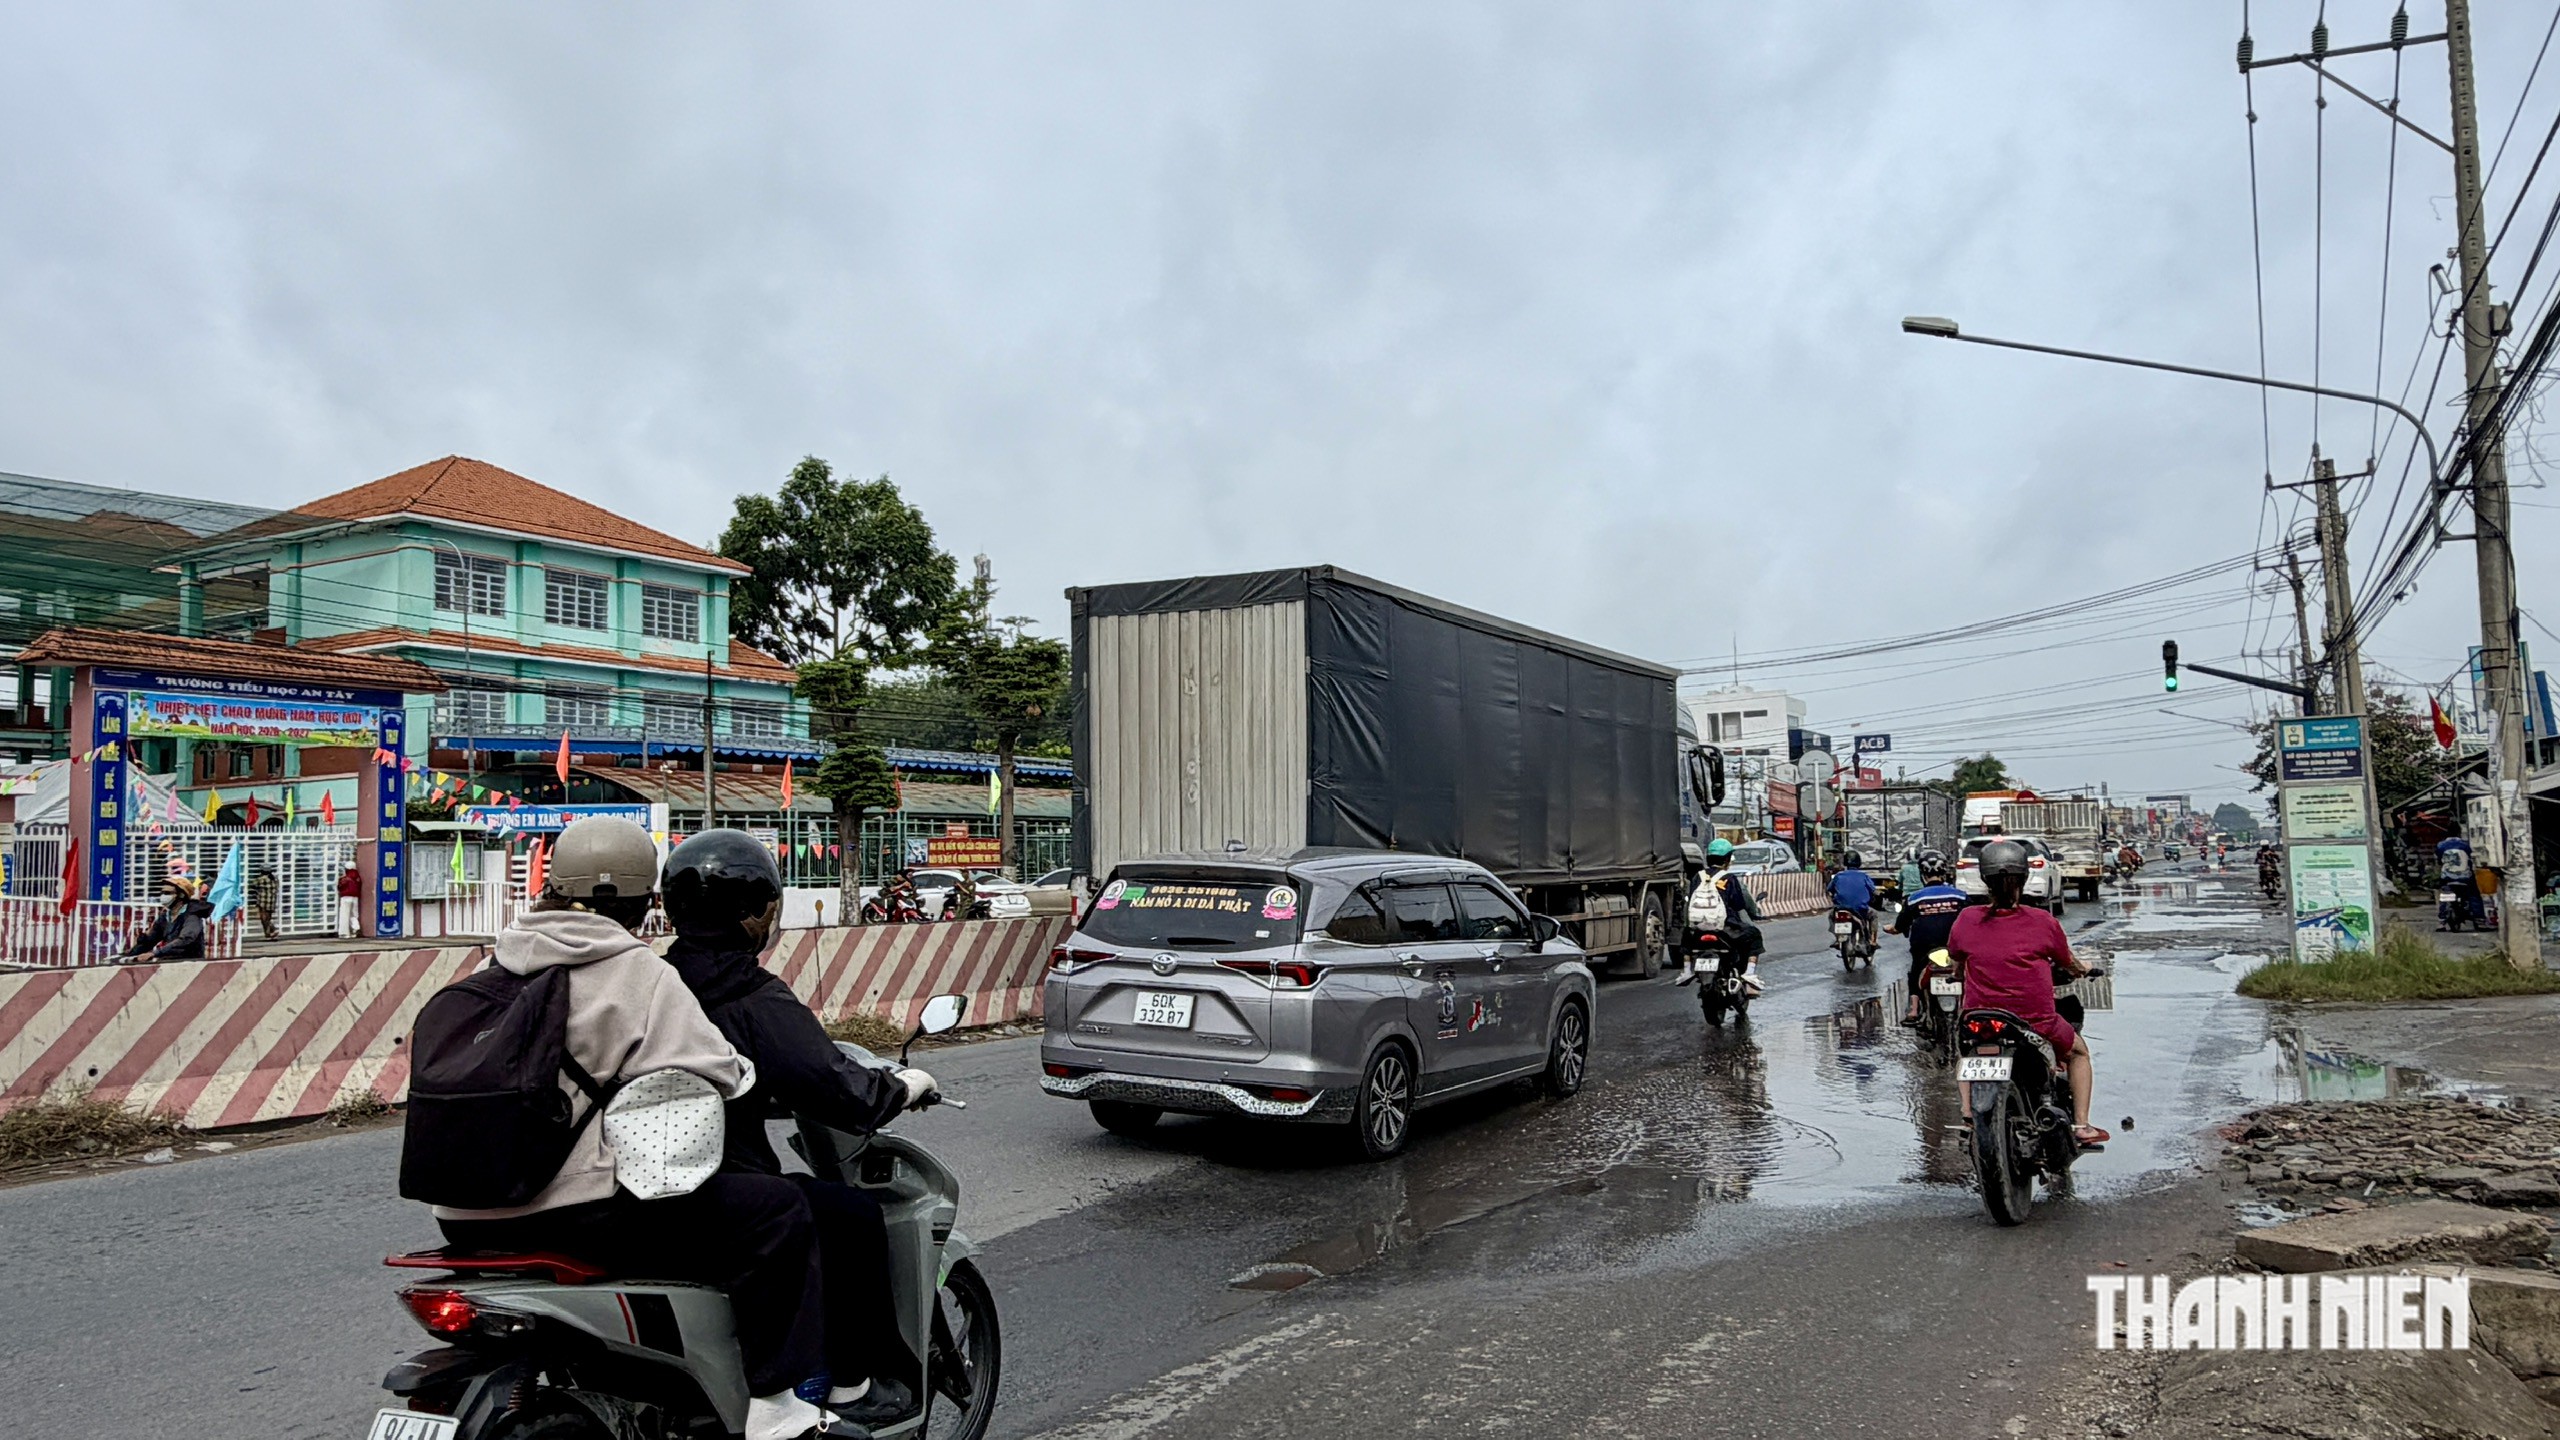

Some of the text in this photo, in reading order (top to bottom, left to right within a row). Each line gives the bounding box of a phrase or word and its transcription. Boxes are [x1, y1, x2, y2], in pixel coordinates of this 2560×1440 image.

[156, 676, 223, 690] TRƯỜNG
[228, 681, 263, 692] TIỂU
[267, 686, 298, 697] HỌC
[301, 689, 322, 697] AN
[326, 689, 355, 700] TÂY
[1859, 737, 1885, 749] ACB
[1172, 898, 1182, 908] A
[1151, 993, 1177, 1009] 60K
